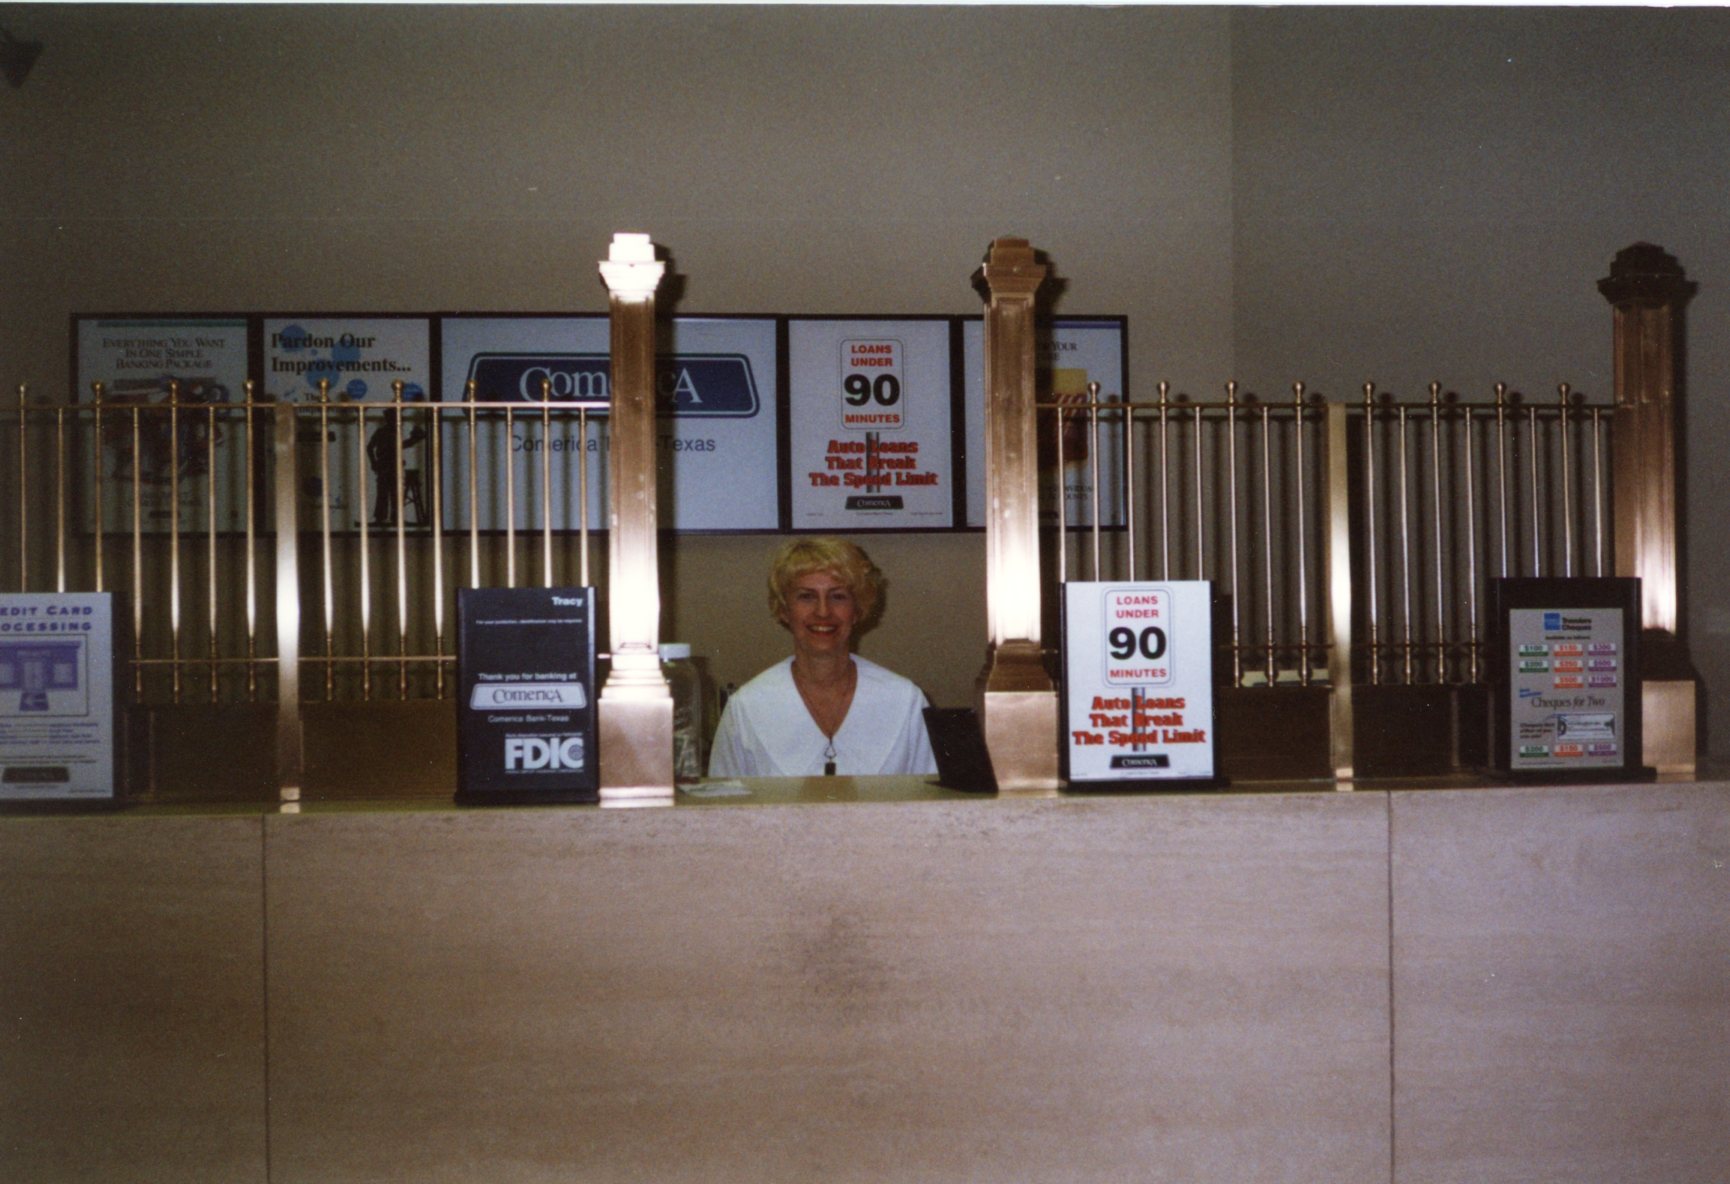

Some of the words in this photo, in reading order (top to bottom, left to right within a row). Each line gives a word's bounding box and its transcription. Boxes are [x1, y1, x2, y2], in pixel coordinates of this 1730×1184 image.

[272, 332, 334, 348] Pardon
[339, 332, 376, 348] Our
[851, 344, 892, 354] LOANS
[271, 357, 412, 375] Improvements...
[851, 358, 893, 367] UNDER
[844, 373, 900, 407] 90
[845, 414, 900, 424] MINUTES
[827, 439, 865, 453] Auto
[870, 439, 918, 453] Loans
[825, 456, 863, 470] That
[868, 456, 916, 469] Break
[808, 472, 839, 486] The
[843, 472, 891, 488] Speed
[896, 472, 938, 485] Limit
[551, 596, 584, 607] Tracy
[1116, 596, 1159, 605] LOANS
[46, 605, 93, 615] CARD
[1116, 609, 1159, 618] UNDER
[1108, 626, 1167, 660] 90
[478, 672, 503, 681] Thank
[504, 673, 521, 683] you
[521, 672, 533, 680] for
[534, 672, 567, 682] banking
[568, 672, 577, 680] at
[1110, 668, 1167, 678] MINUTES
[1091, 696, 1131, 710] Auto
[1135, 695, 1185, 709] Loans
[1531, 697, 1572, 710] Cheques
[1572, 697, 1585, 708] for
[1587, 696, 1606, 707] Two
[488, 714, 524, 723] Comerica
[1089, 713, 1128, 728] That
[1133, 712, 1183, 727] Break
[1071, 731, 1104, 745] The
[1108, 730, 1158, 747] Speed
[1162, 729, 1206, 743] Limit
[505, 737, 584, 769] FDIC
